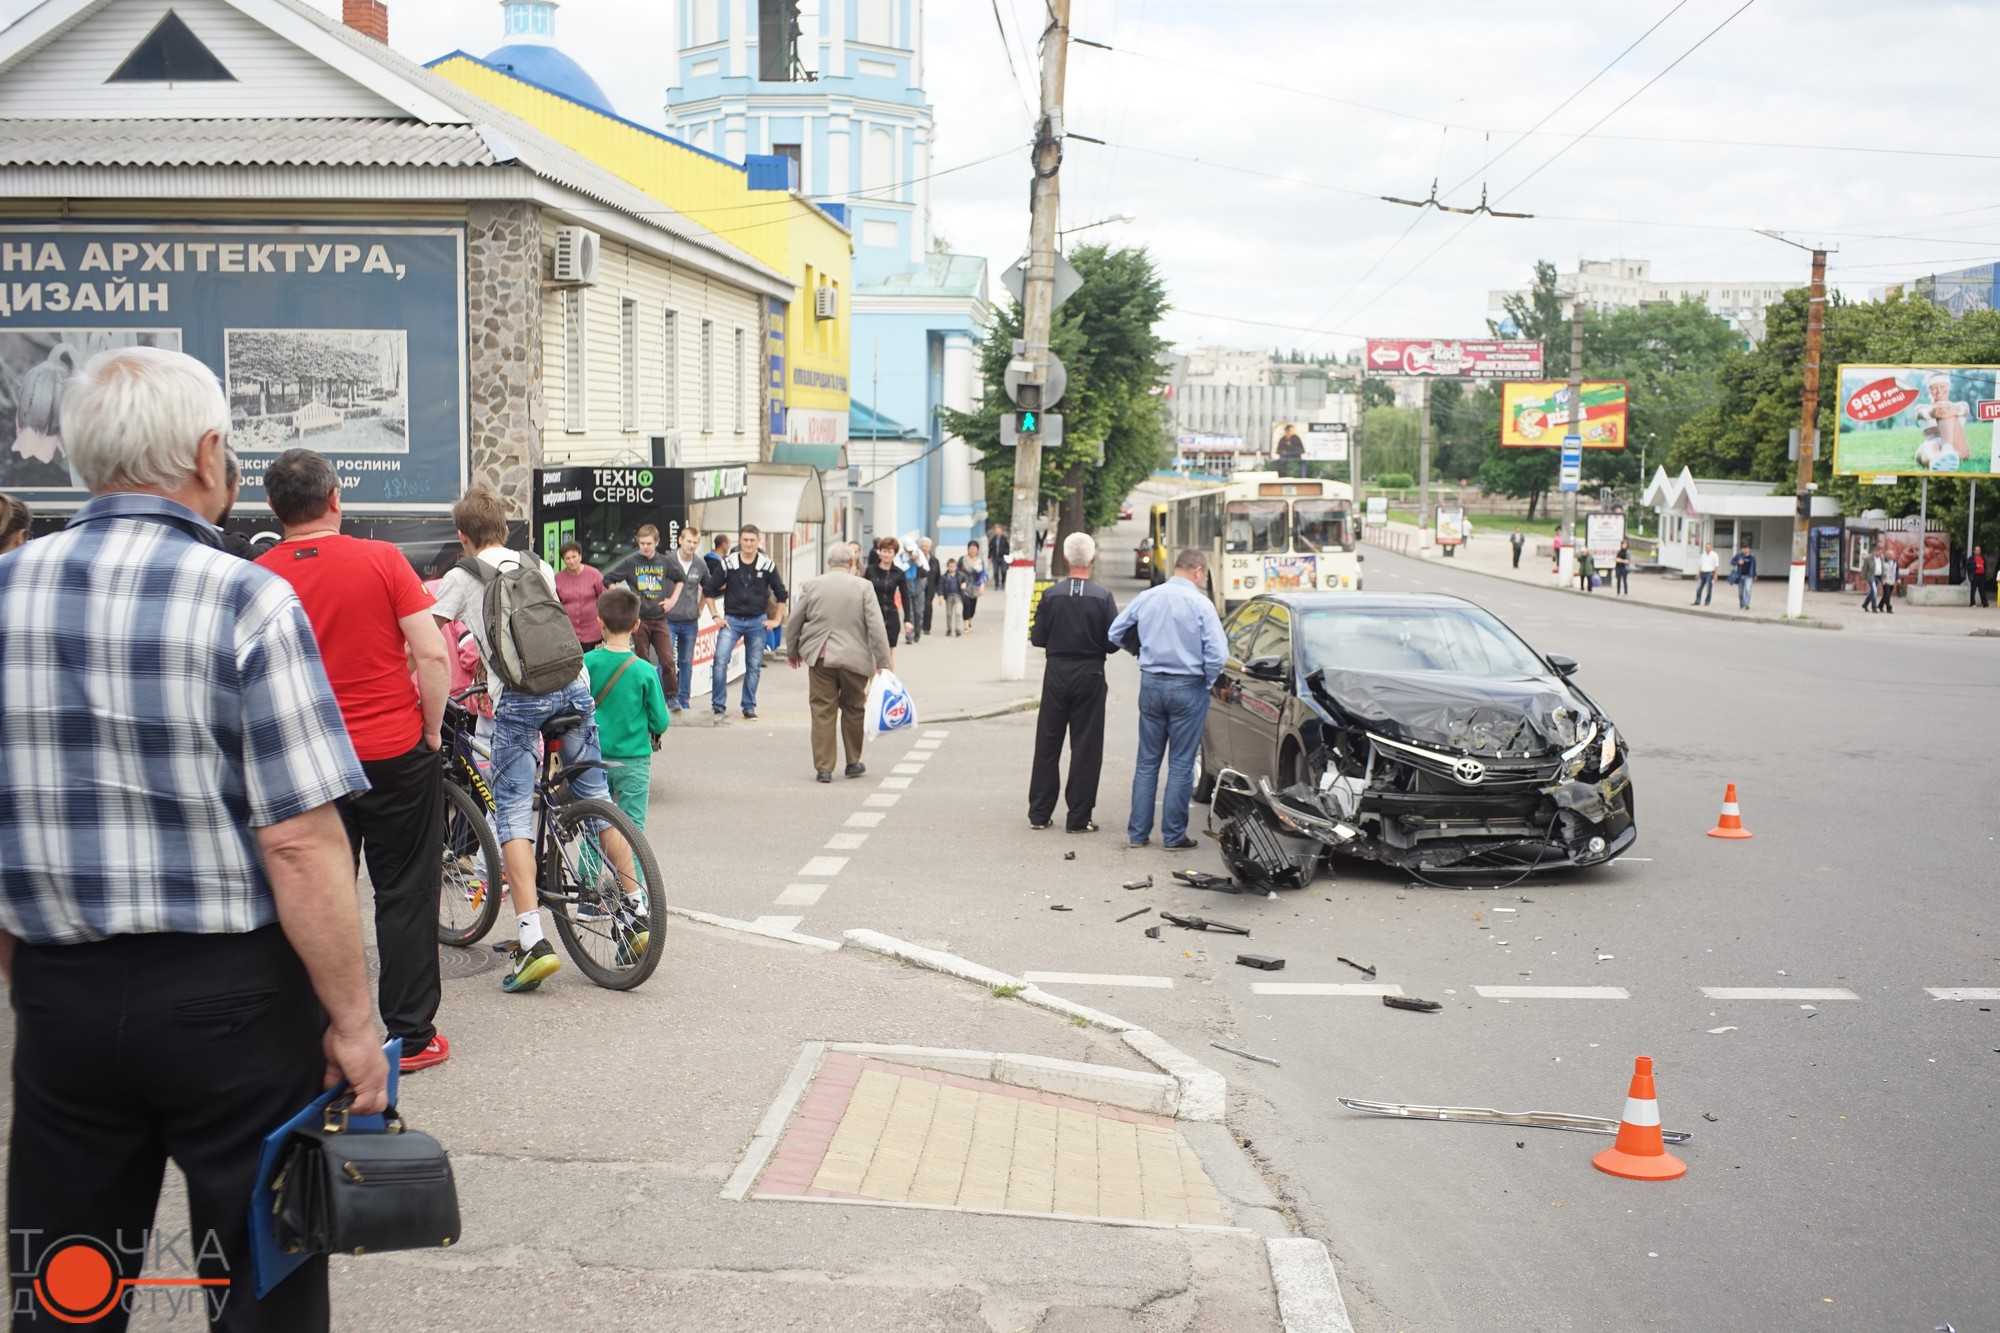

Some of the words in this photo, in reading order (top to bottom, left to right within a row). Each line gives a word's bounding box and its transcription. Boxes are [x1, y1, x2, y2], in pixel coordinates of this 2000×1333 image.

[3, 242, 66, 272] НА
[79, 242, 407, 281] АРХІТЕКТУРА,
[1851, 389, 1882, 411] 969
[337, 460, 400, 471] РОСЛИНИ
[593, 469, 654, 487] ТЕХНО
[593, 487, 654, 503] СЕРВІС
[669, 520, 680, 554] ентр
[1232, 559, 1249, 569] 236
